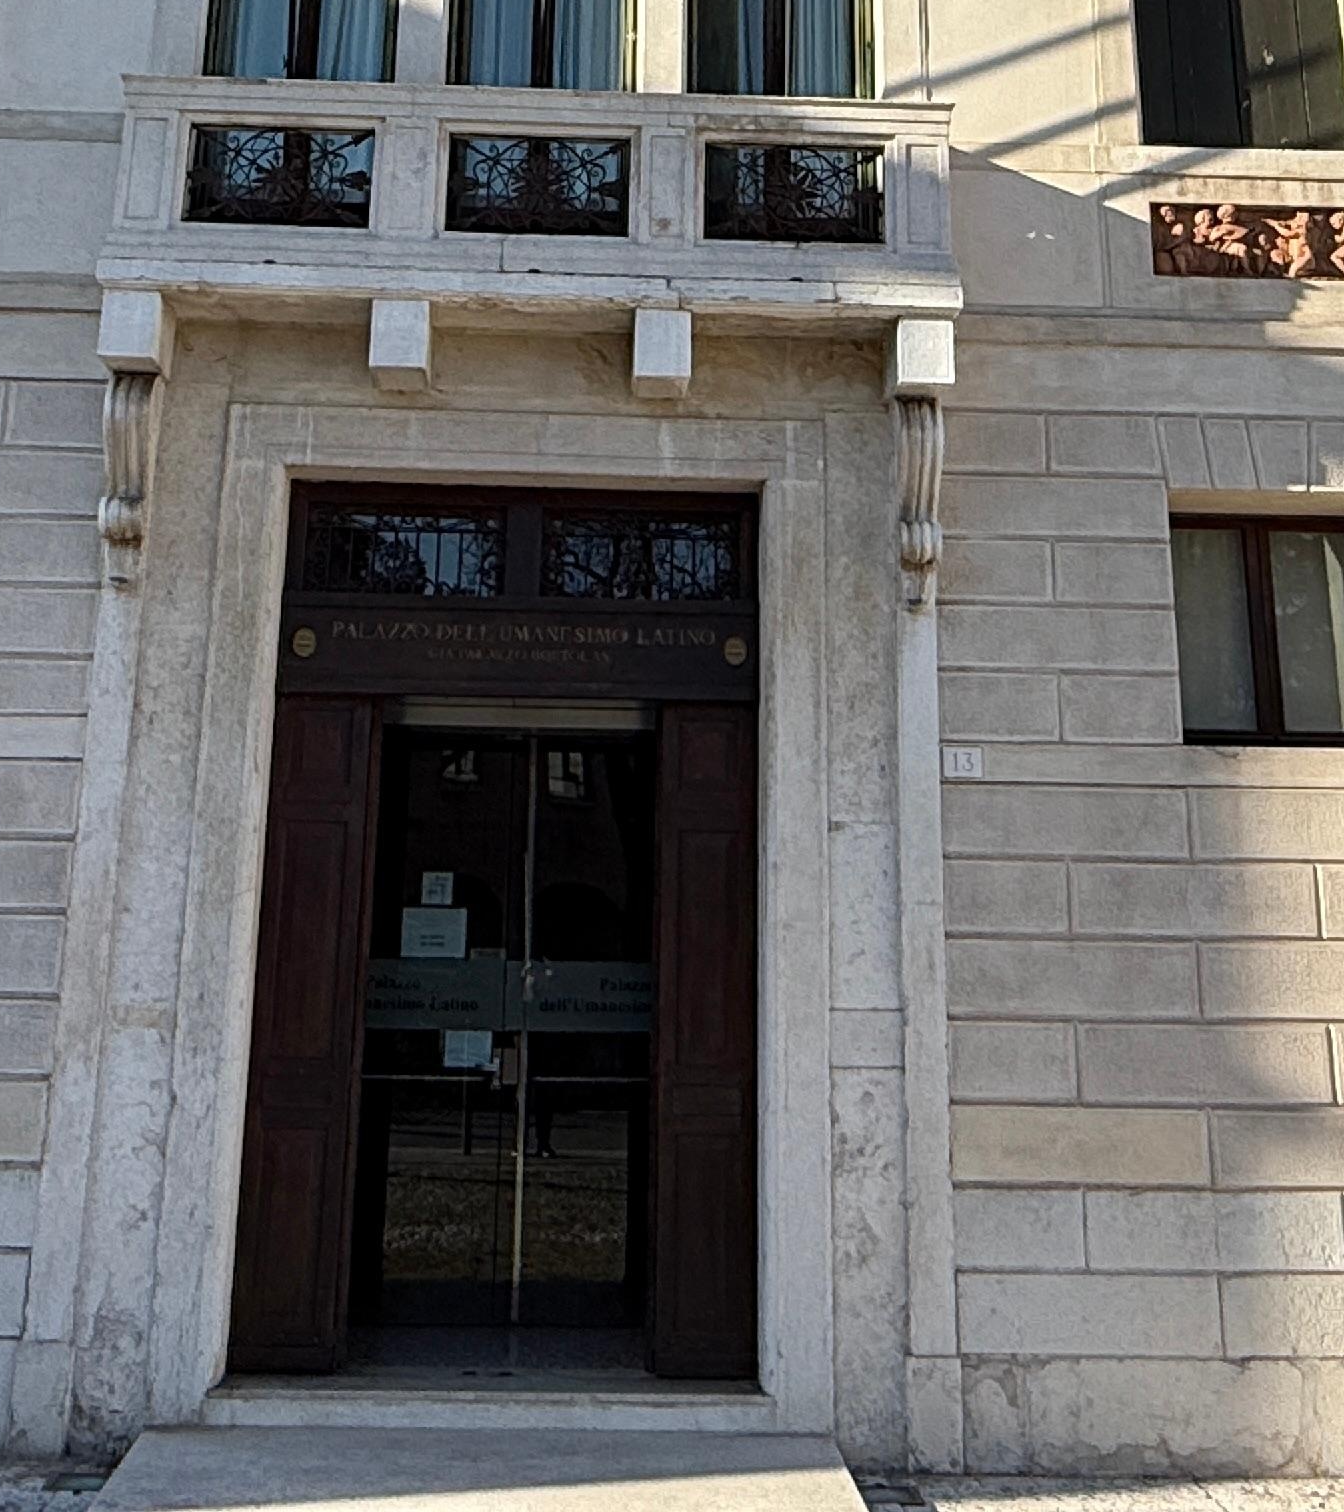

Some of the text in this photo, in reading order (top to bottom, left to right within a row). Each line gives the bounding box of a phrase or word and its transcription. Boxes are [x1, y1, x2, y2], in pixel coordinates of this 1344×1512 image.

[331, 620, 429, 641] PALAZZO
[635, 628, 717, 647] LATINO
[952, 751, 975, 773] 13
